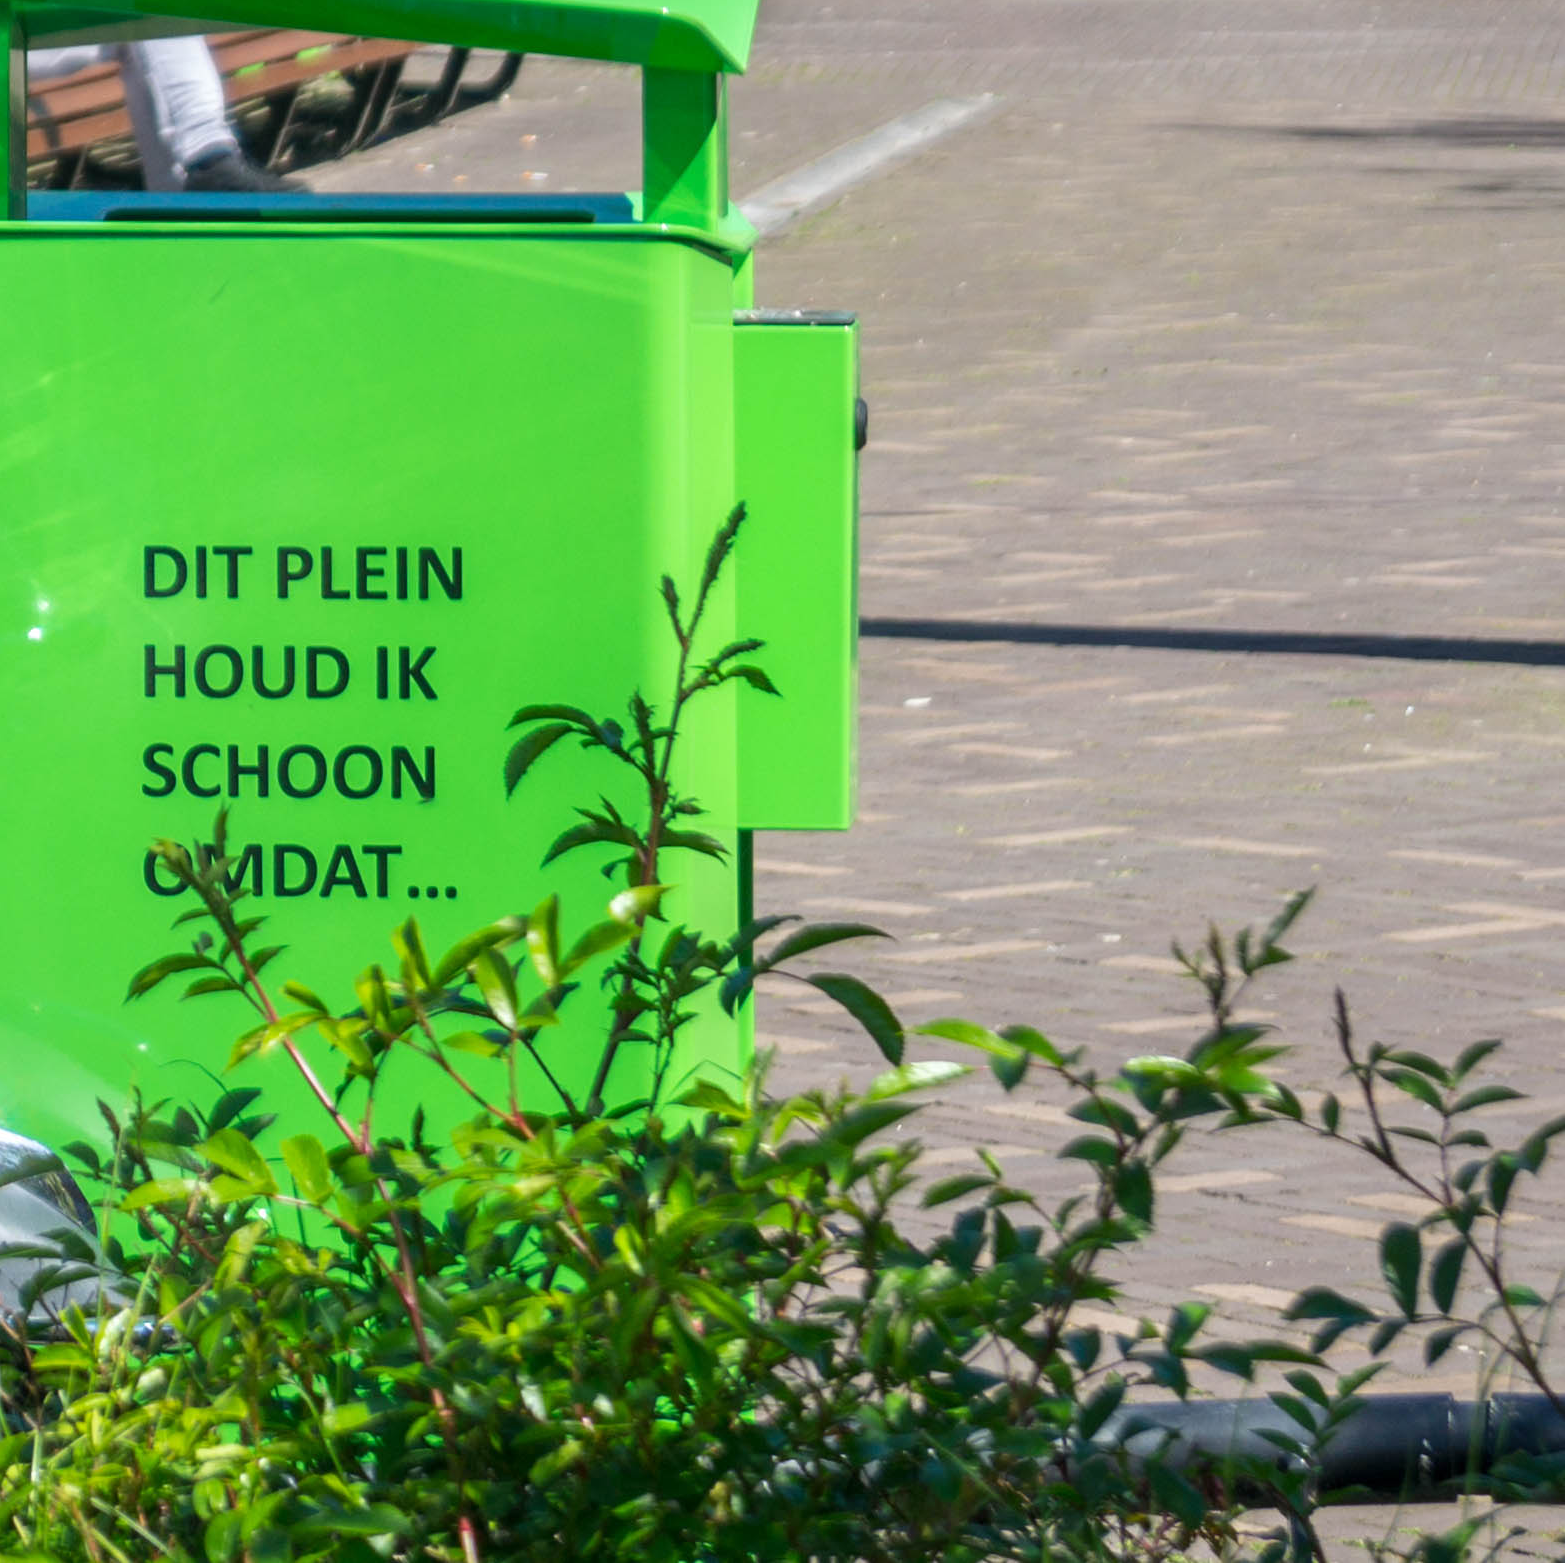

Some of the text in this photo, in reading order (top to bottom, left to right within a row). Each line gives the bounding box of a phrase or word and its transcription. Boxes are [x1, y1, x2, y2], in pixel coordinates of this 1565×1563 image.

[144, 545, 463, 601] DIT PLEIN
[144, 644, 438, 700] HOUD IK
[141, 742, 436, 800] SCHOON
